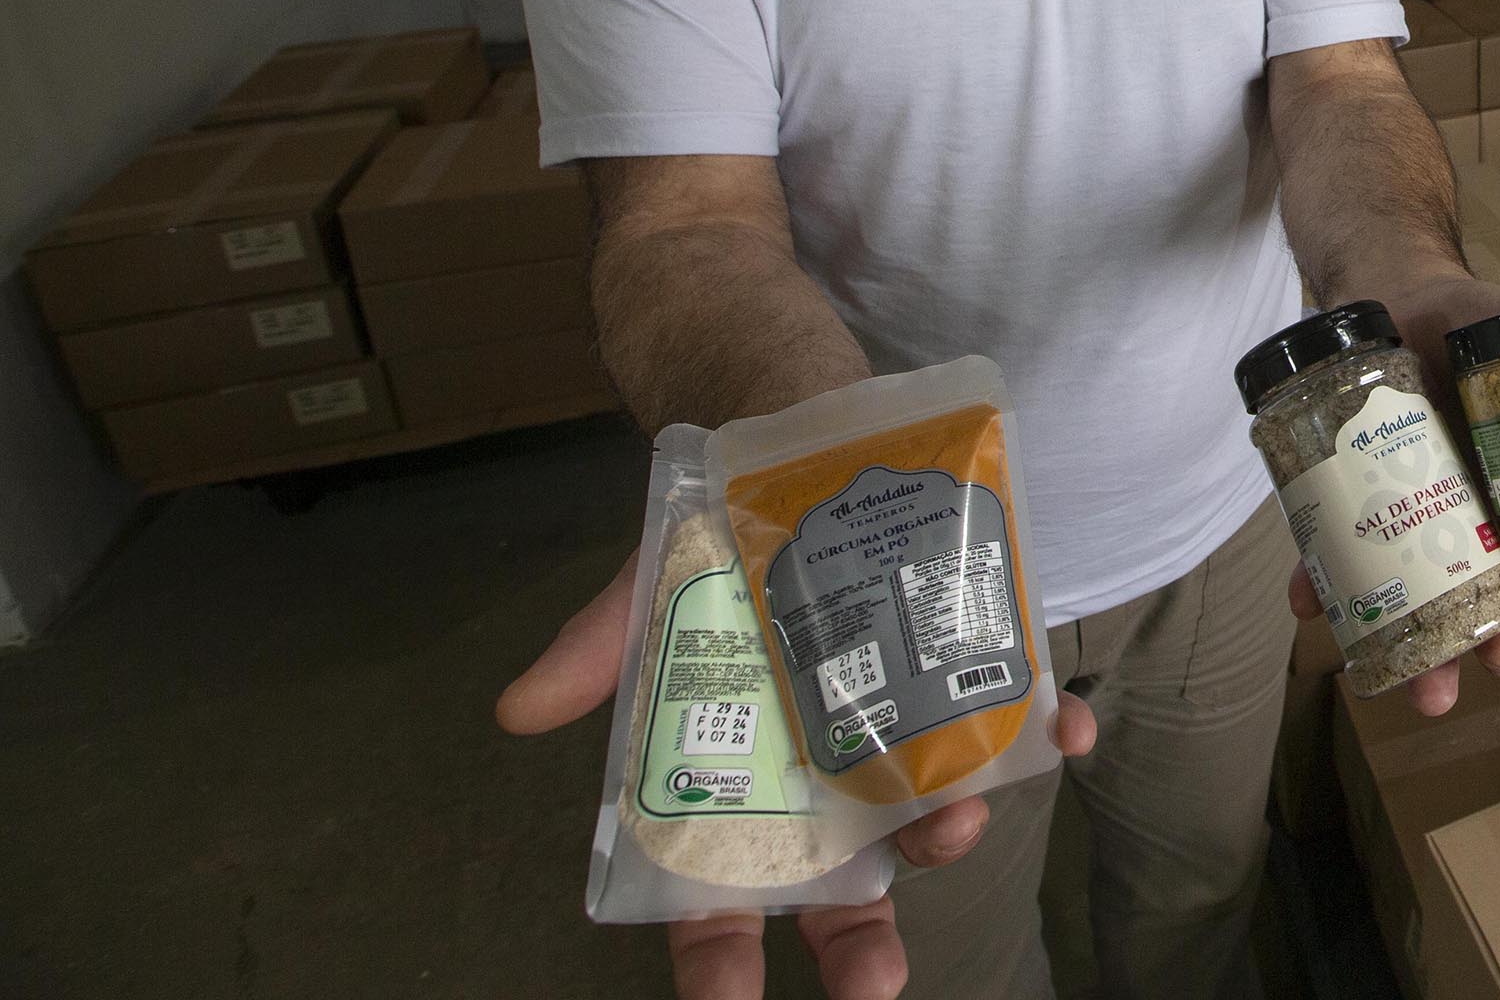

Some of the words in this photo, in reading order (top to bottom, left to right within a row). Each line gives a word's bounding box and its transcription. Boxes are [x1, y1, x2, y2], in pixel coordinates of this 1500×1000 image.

[1372, 432, 1428, 460] TEMPEROS
[847, 503, 915, 530] TEMPEROS
[1354, 512, 1387, 538] SAL
[1388, 497, 1413, 518] DE
[1377, 489, 1470, 542] TEMPERADO
[806, 533, 881, 565] CÚRCUMA
[883, 506, 961, 538] ORGÂNICA
[864, 546, 885, 560] EM
[888, 535, 909, 550] PÓ
[879, 555, 895, 568] 100
[1446, 560, 1472, 577] 500g
[925, 573, 939, 582] NÃO
[963, 570, 988, 578] uantidade
[1354, 583, 1403, 616] ORGÂNICO
[1384, 592, 1406, 606] BRASIL
[839, 653, 851, 667] 27
[857, 646, 871, 659] 24
[839, 667, 852, 681] 07
[859, 660, 872, 673] 24
[832, 688, 838, 698] V
[844, 679, 856, 692] 07
[863, 671, 877, 685] 26
[703, 703, 710, 712] L
[717, 703, 732, 713] 29
[737, 705, 751, 716] 24
[697, 716, 706, 727] F
[711, 717, 727, 728] 07
[733, 719, 746, 730] 24
[697, 730, 705, 741] V
[710, 731, 726, 742] 07
[731, 733, 745, 744] 26
[674, 772, 750, 791] ORGÂNICO
[720, 786, 747, 794] BRASIL
